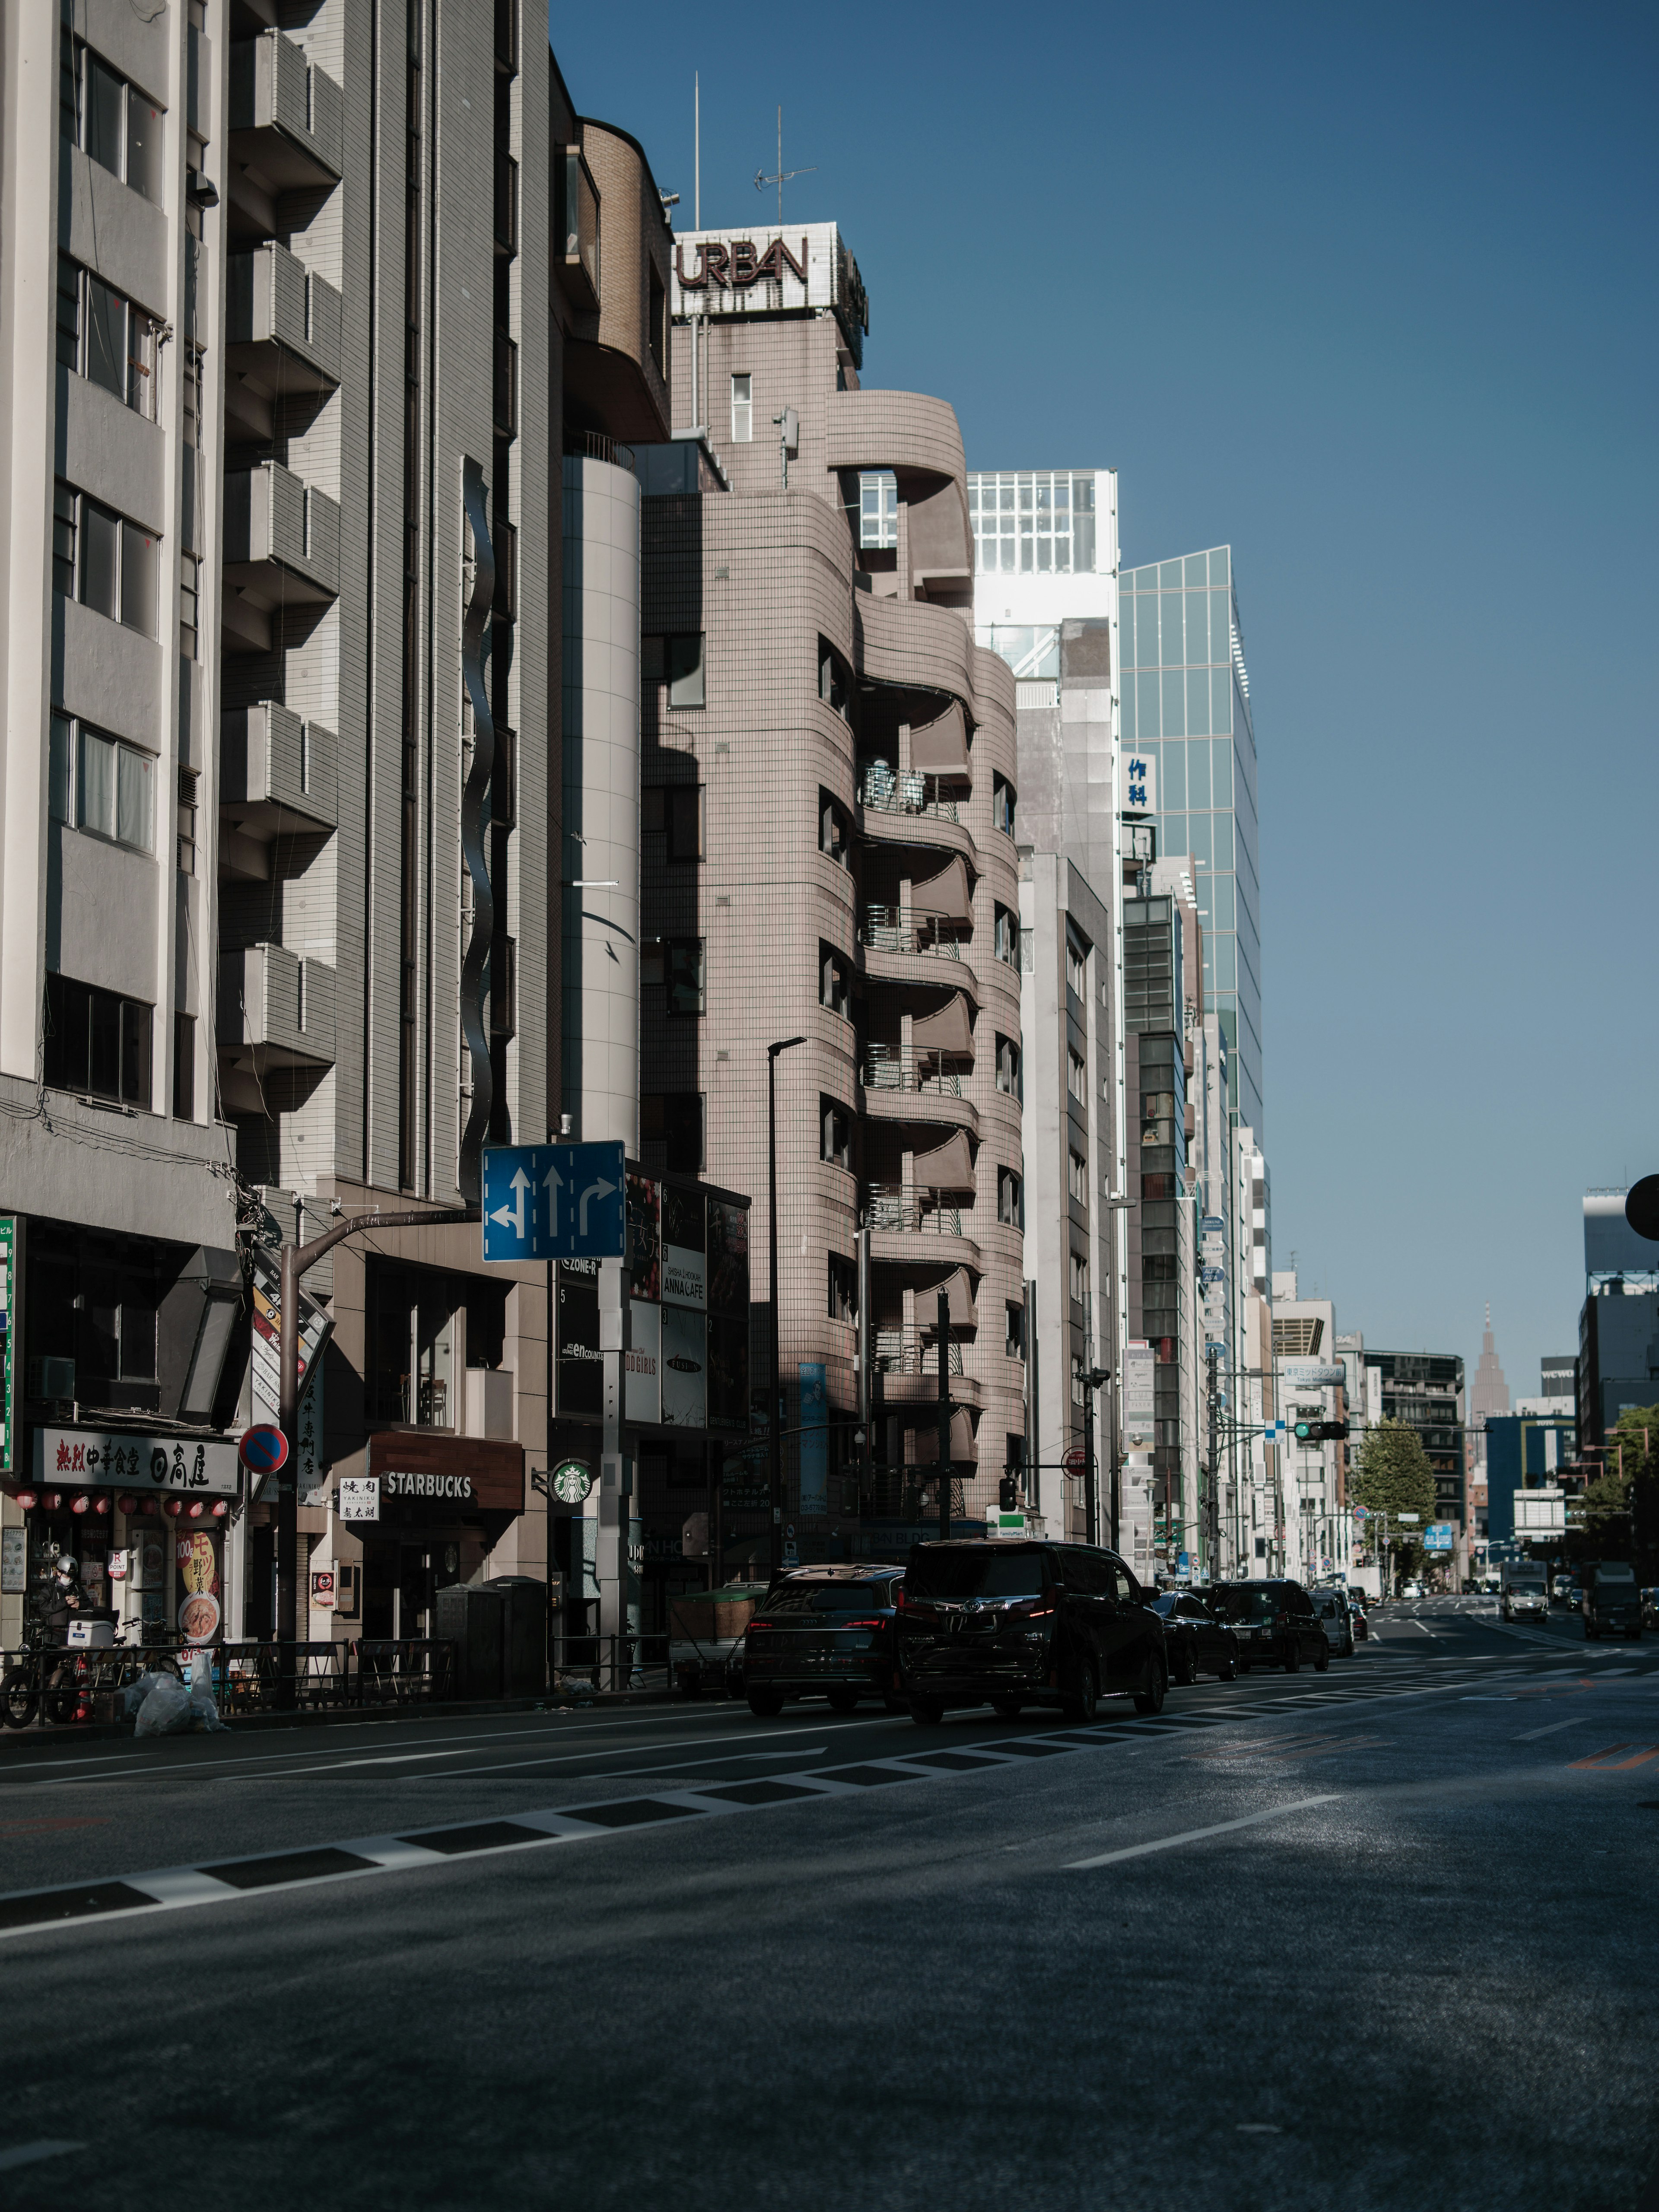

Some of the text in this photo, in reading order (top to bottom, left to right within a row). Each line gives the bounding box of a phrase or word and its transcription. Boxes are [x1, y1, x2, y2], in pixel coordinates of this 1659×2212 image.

[676, 236, 808, 286] URBAN
[8, 1249, 12, 1257] 9
[8, 1271, 12, 1280] 8
[270, 1269, 280, 1281] BAR
[8, 1294, 12, 1303] 7
[561, 1289, 566, 1303] 5
[7, 1316, 11, 1325] 6
[663, 1309, 667, 1324] 3
[7, 1339, 11, 1348] 5
[6, 1362, 11, 1371] 4
[1287, 1368, 1342, 1376] 東京ミッドタウン前
[6, 1384, 11, 1393] 3
[6, 1407, 10, 1416] 2
[57, 1438, 210, 1489] 熱烈中華食堂 日高屋
[388, 1471, 471, 1498] STARBUCKS
[176, 1540, 194, 1559] 100g
[114, 1553, 121, 1562] R
[193, 1558, 203, 1595] 野菜
